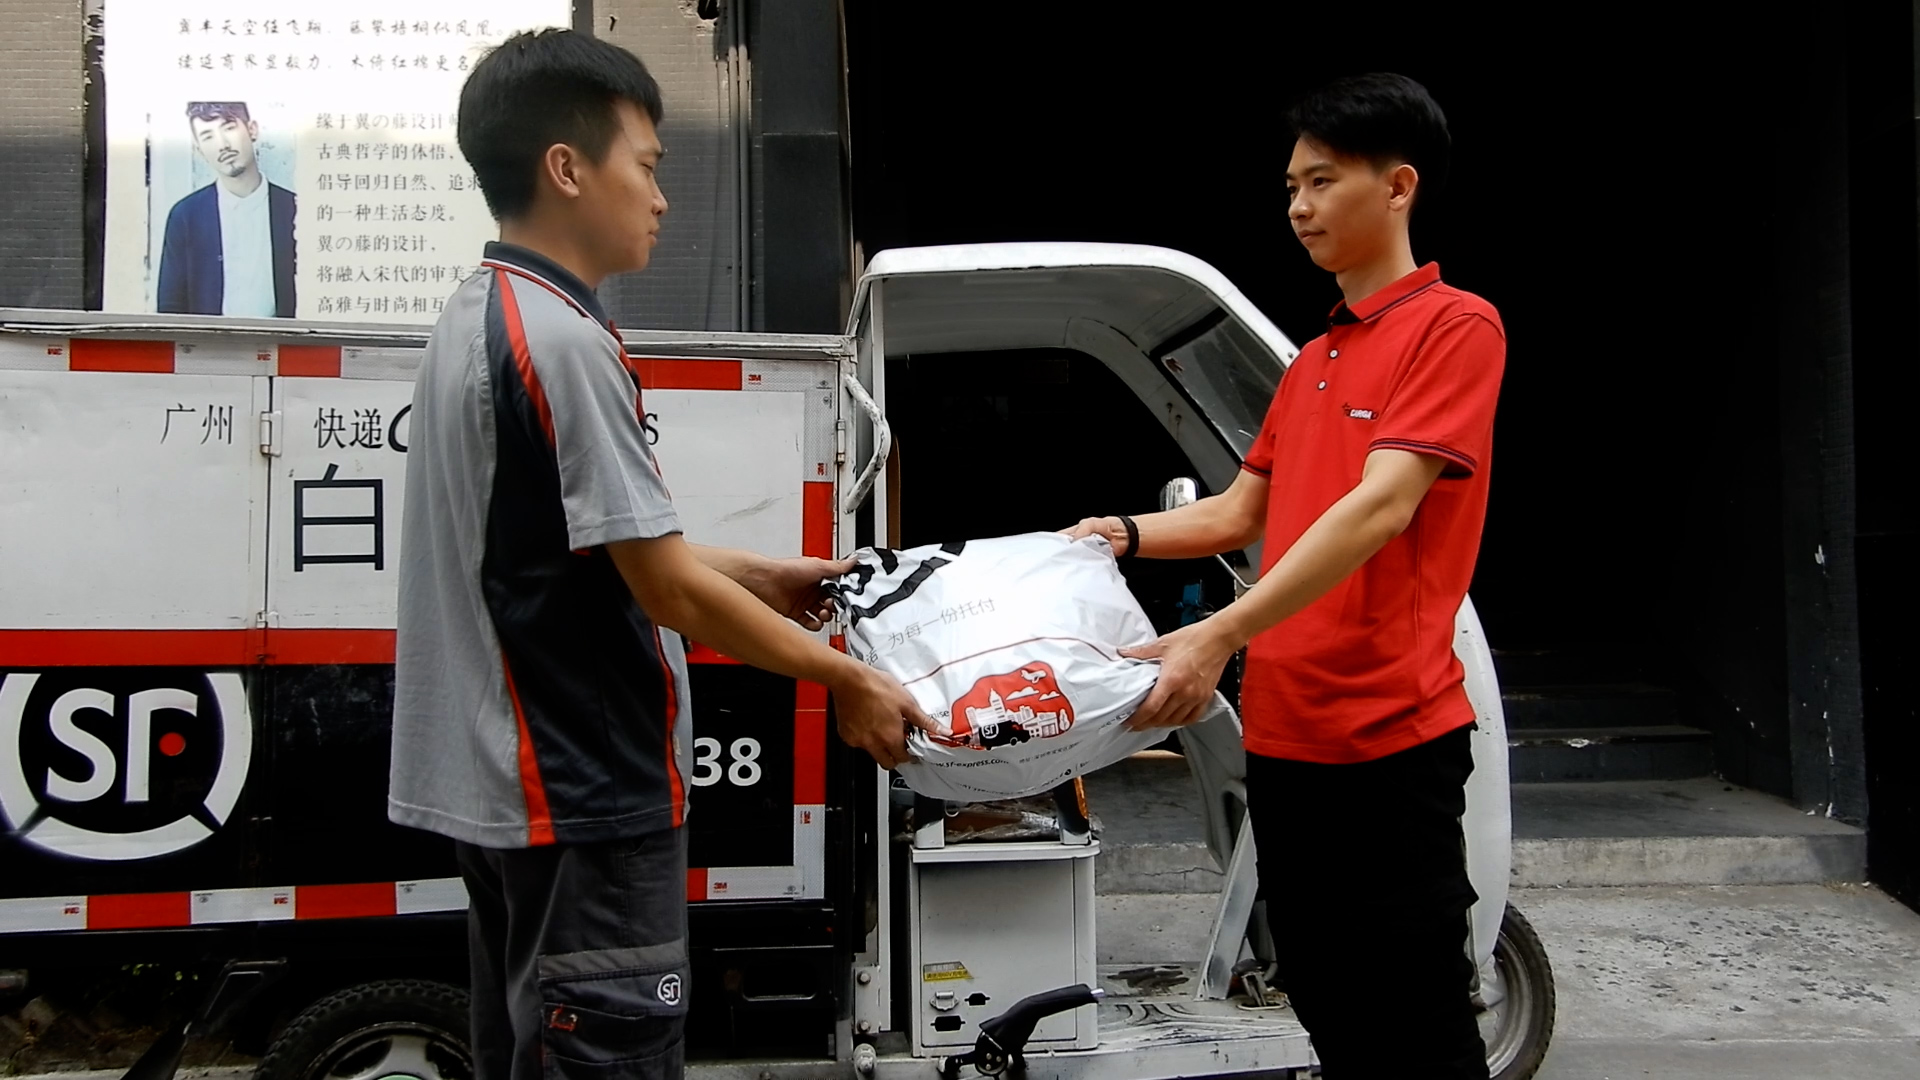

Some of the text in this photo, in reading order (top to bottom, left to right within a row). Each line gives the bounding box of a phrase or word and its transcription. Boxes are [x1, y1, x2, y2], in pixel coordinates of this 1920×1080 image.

[748, 374, 762, 382] 3M
[160, 402, 384, 449] 广州 快递
[293, 463, 385, 573] 白
[888, 598, 996, 650] 为每一份托付
[47, 688, 198, 803] SF
[691, 737, 762, 787] 38
